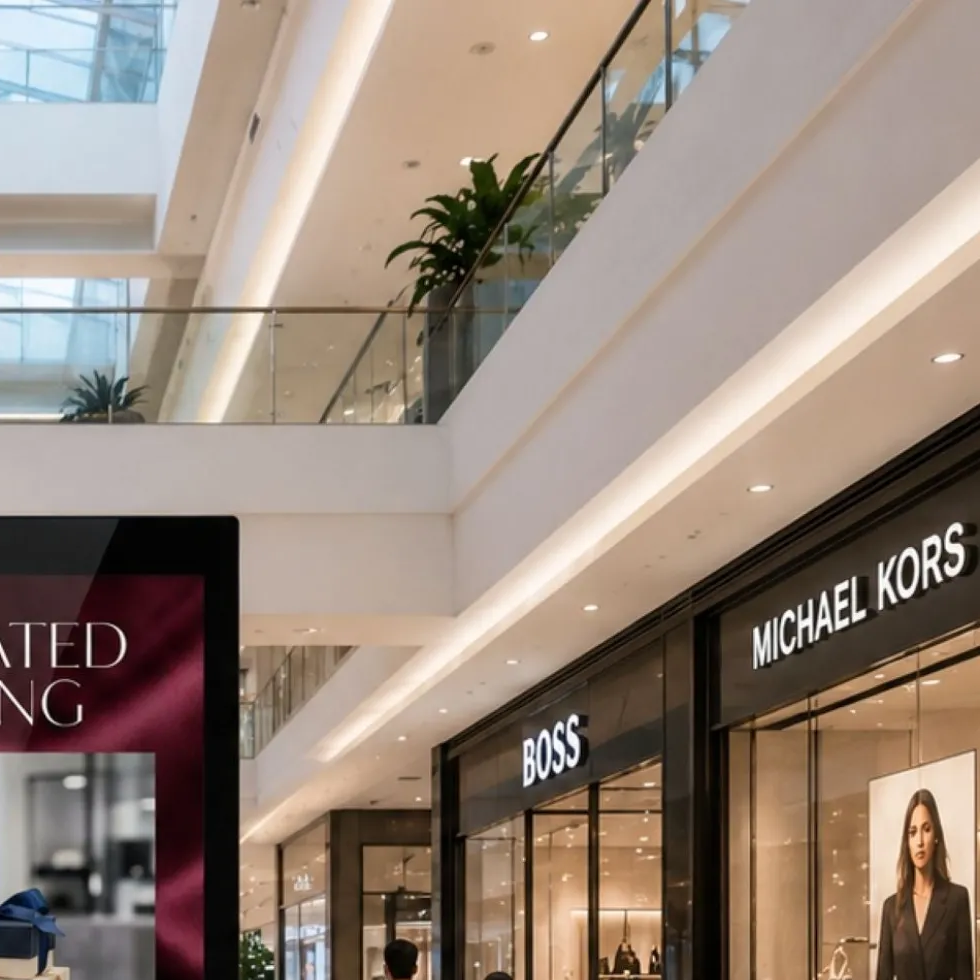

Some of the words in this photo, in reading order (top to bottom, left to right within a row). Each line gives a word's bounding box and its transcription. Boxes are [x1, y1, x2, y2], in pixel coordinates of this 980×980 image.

[752, 575, 867, 670] MICHAEL
[877, 521, 966, 611] KORS
[522, 712, 581, 788] BOSS
